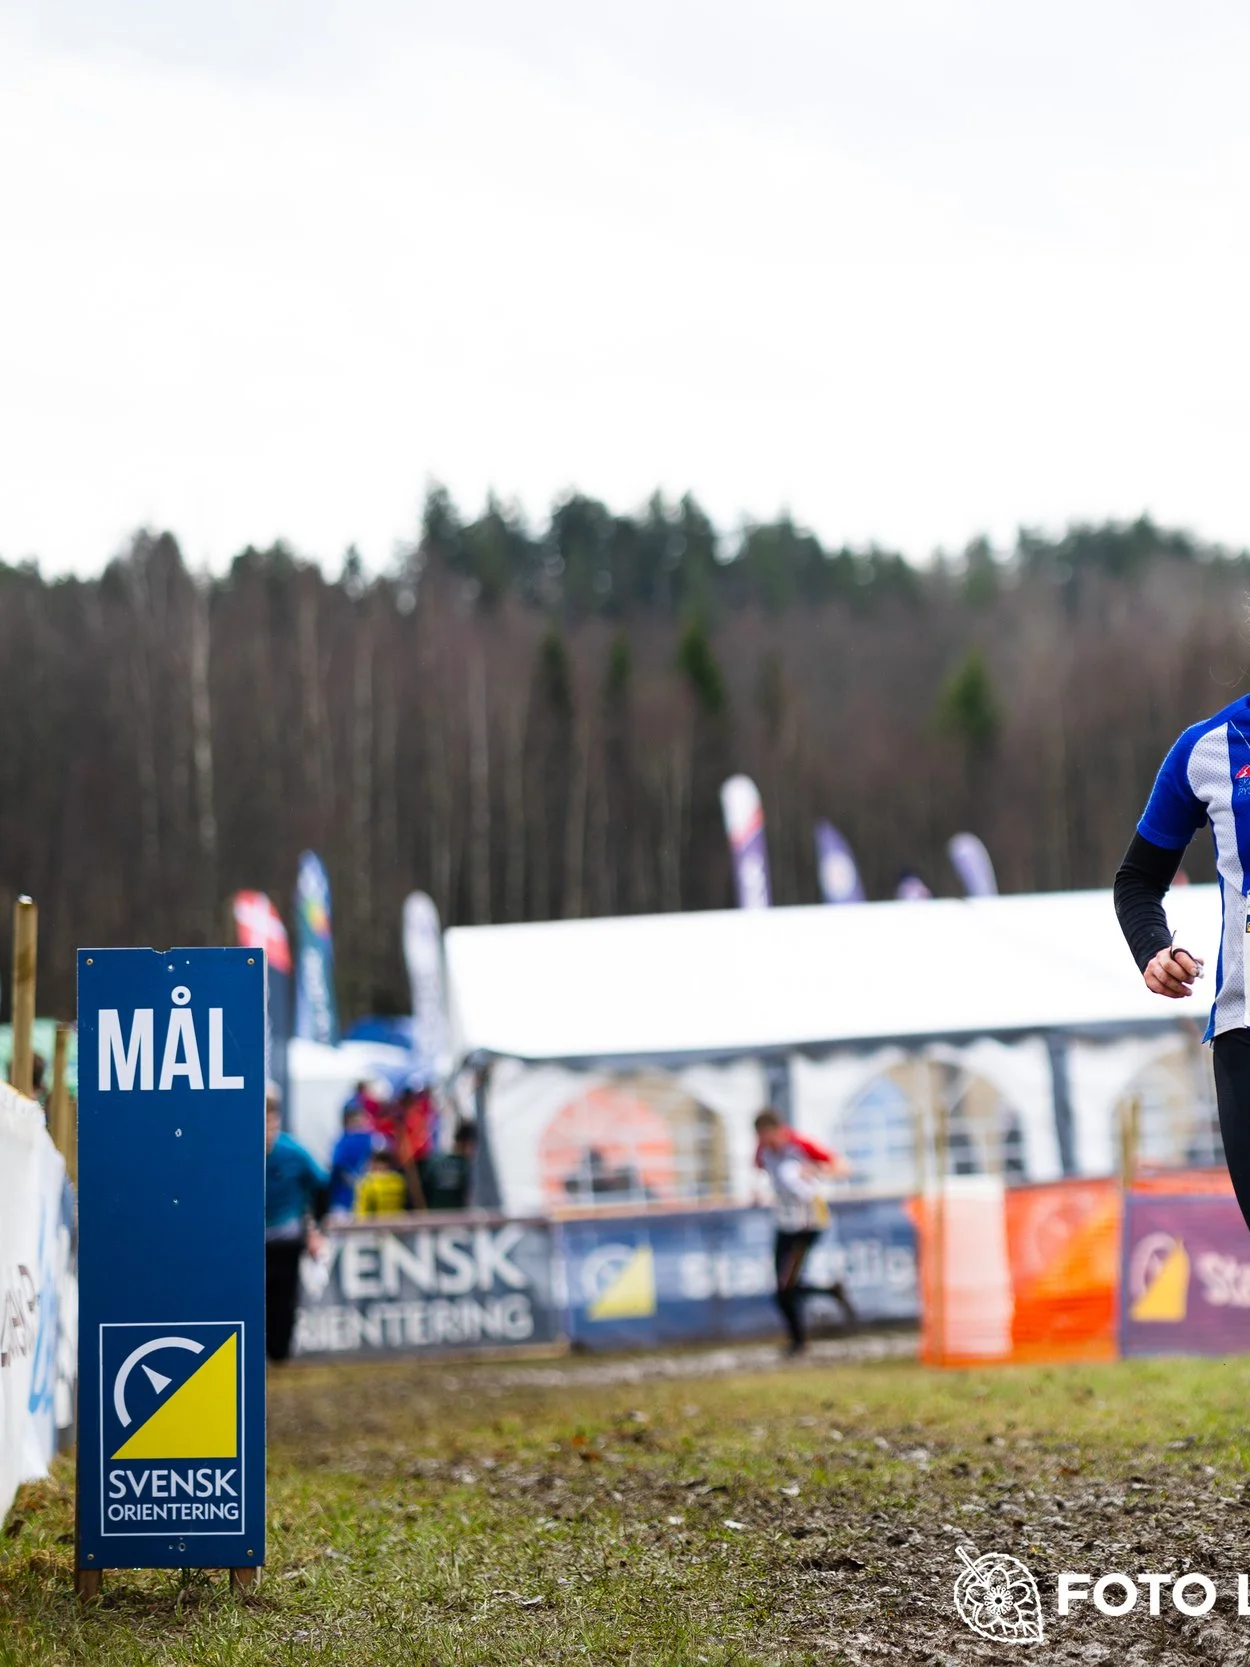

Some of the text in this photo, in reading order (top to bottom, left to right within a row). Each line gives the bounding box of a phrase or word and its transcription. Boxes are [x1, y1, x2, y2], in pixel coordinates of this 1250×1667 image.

[98, 985, 245, 1091] MÅL
[298, 1226, 526, 1299] VENSK
[294, 1296, 535, 1351] RIENTERING
[109, 1468, 239, 1498] SVENSK
[107, 1502, 239, 1522] ORIENTERING
